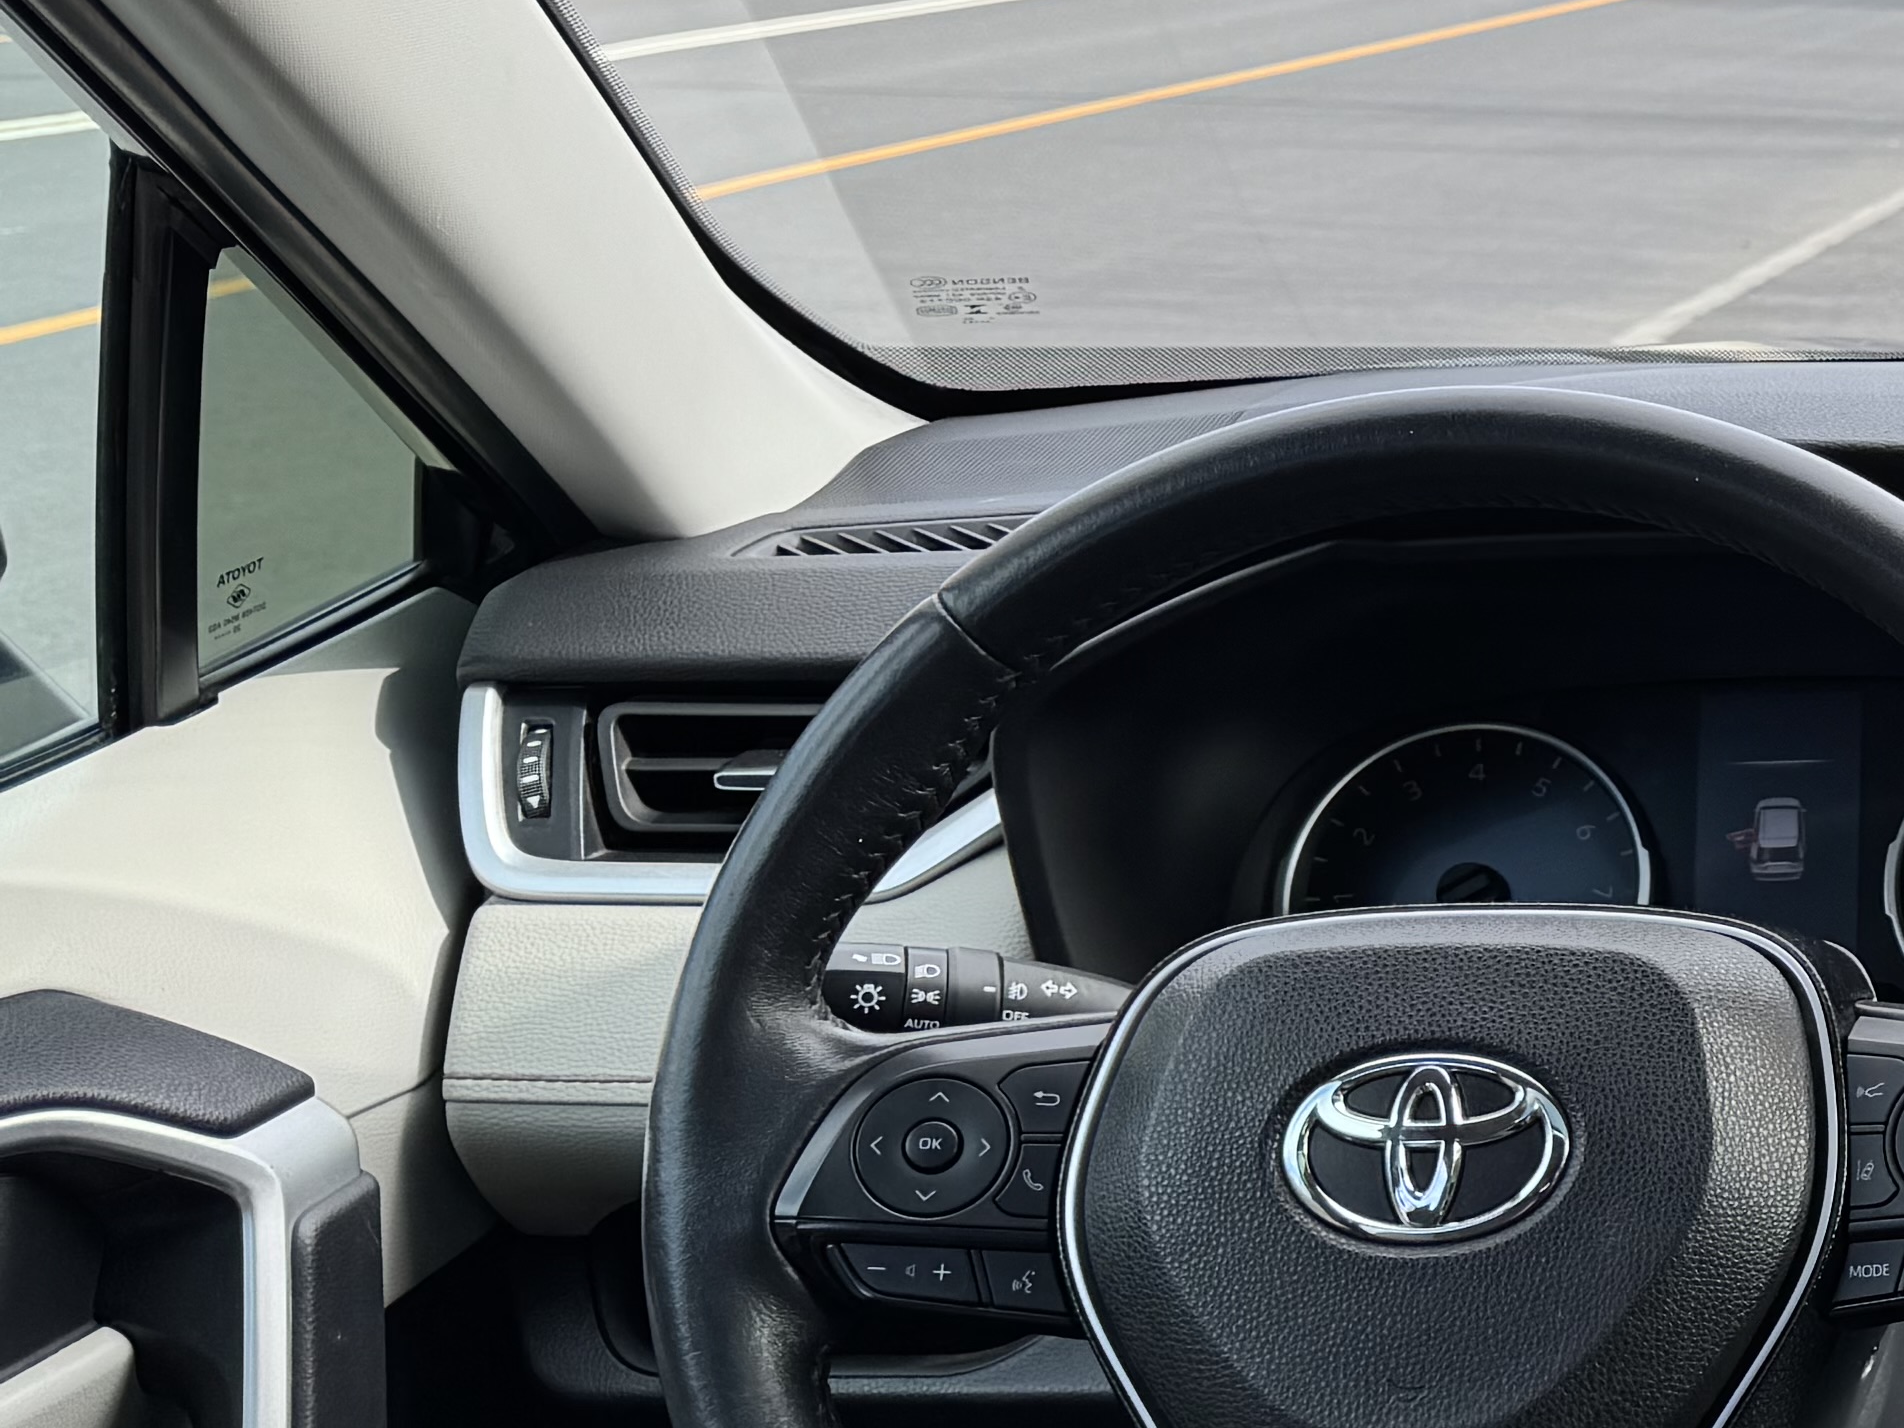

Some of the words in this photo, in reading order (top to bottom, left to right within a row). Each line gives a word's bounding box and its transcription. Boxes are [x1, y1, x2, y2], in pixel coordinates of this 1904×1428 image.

[1467, 762, 1486, 781] 4
[1403, 780, 1424, 801] 3
[1531, 776, 1552, 798] 5
[1575, 823, 1597, 841] 6
[1002, 1010, 1029, 1021] OFF
[904, 1018, 940, 1030] AUTO
[918, 1137, 942, 1150] OK
[1849, 1263, 1890, 1278] MODE
